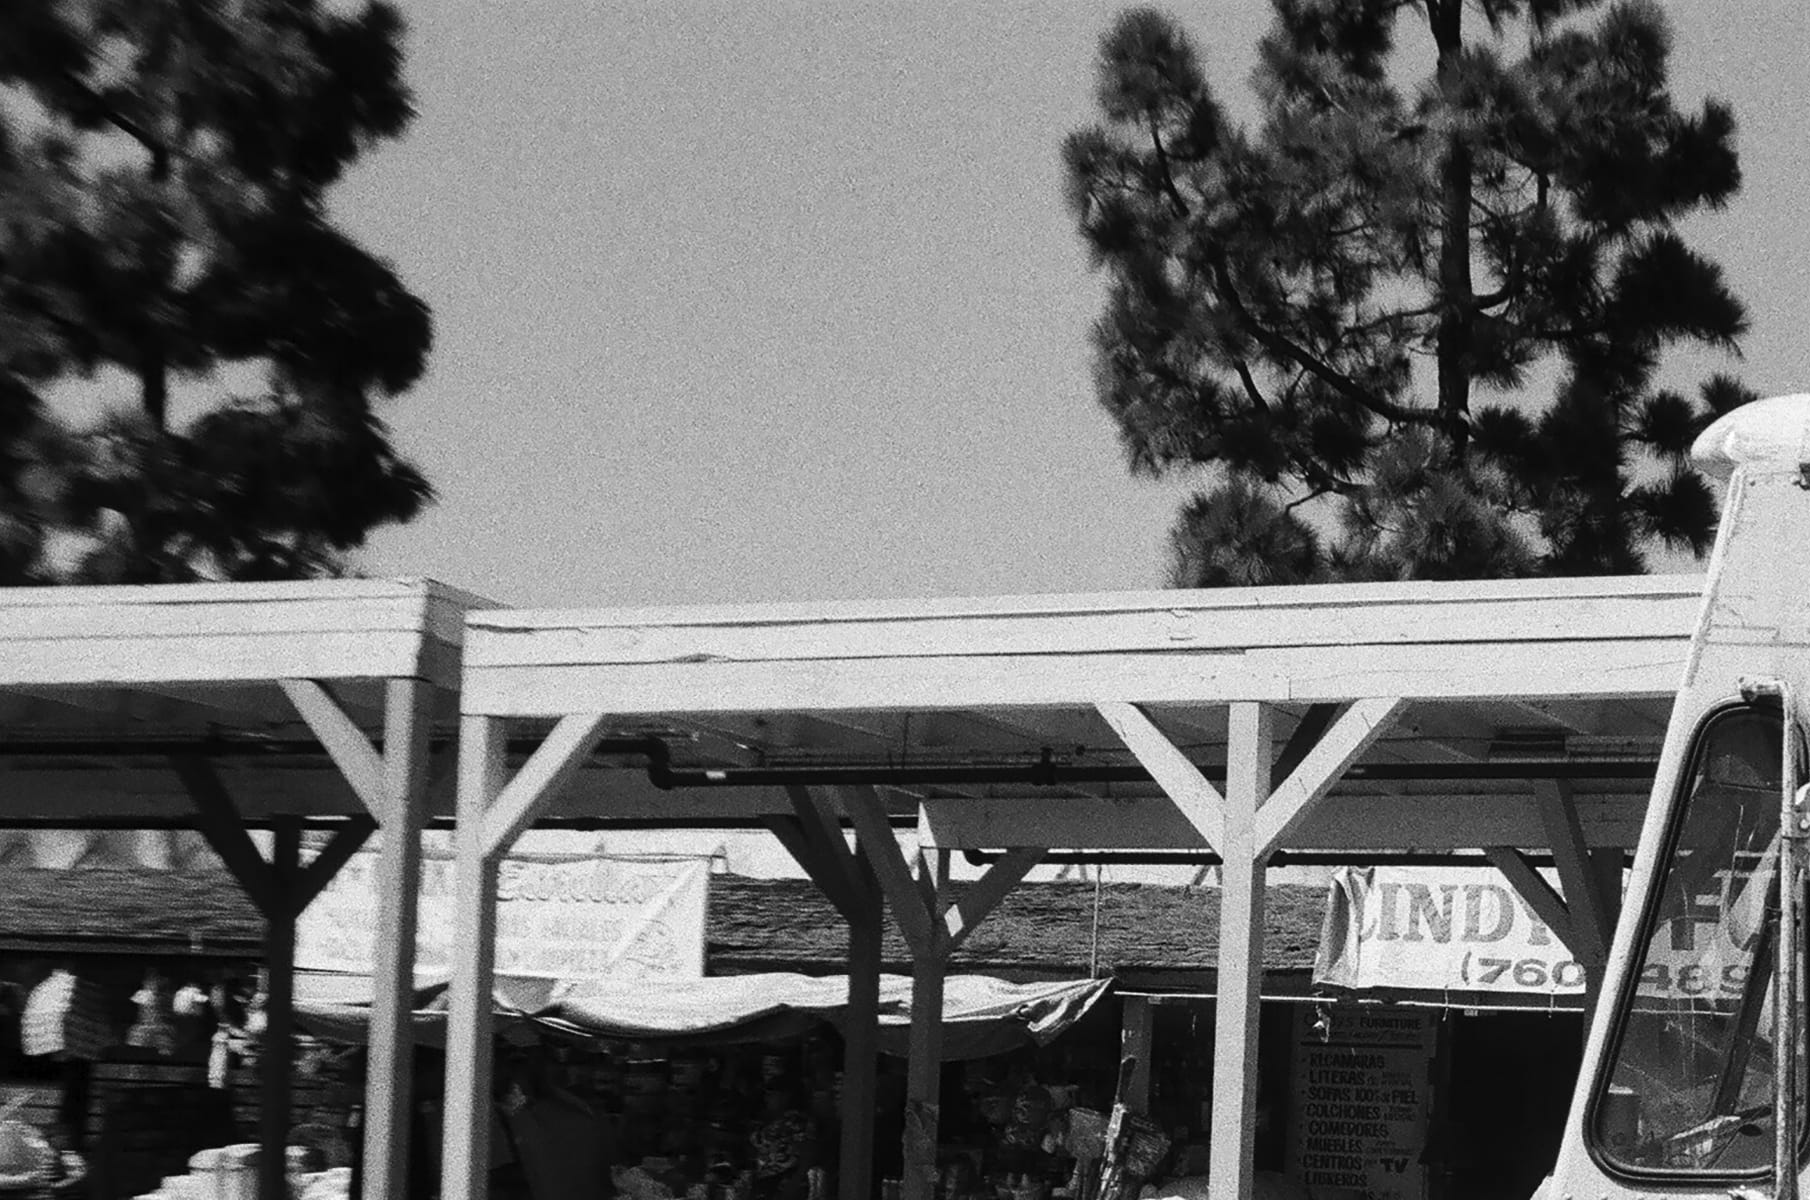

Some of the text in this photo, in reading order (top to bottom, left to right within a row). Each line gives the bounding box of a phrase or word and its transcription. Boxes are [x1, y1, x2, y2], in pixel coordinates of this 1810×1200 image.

[1360, 882, 1552, 947] INDY
[1461, 950, 1587, 987] (760
[1359, 1016, 1422, 1031] FURNITURE
[1309, 1053, 1385, 1069] RECAMARAS
[1308, 1069, 1365, 1086] LITERAS
[1307, 1086, 1350, 1102] SOFAS
[1391, 1089, 1419, 1105] PIEL
[1306, 1102, 1380, 1121] COLCHONES
[1308, 1120, 1390, 1138] COMEDORES
[1306, 1137, 1363, 1153] MUEBLES
[1303, 1154, 1362, 1171] CENTROS
[1380, 1158, 1410, 1173] TV
[1304, 1171, 1368, 1187] LIBREROS
